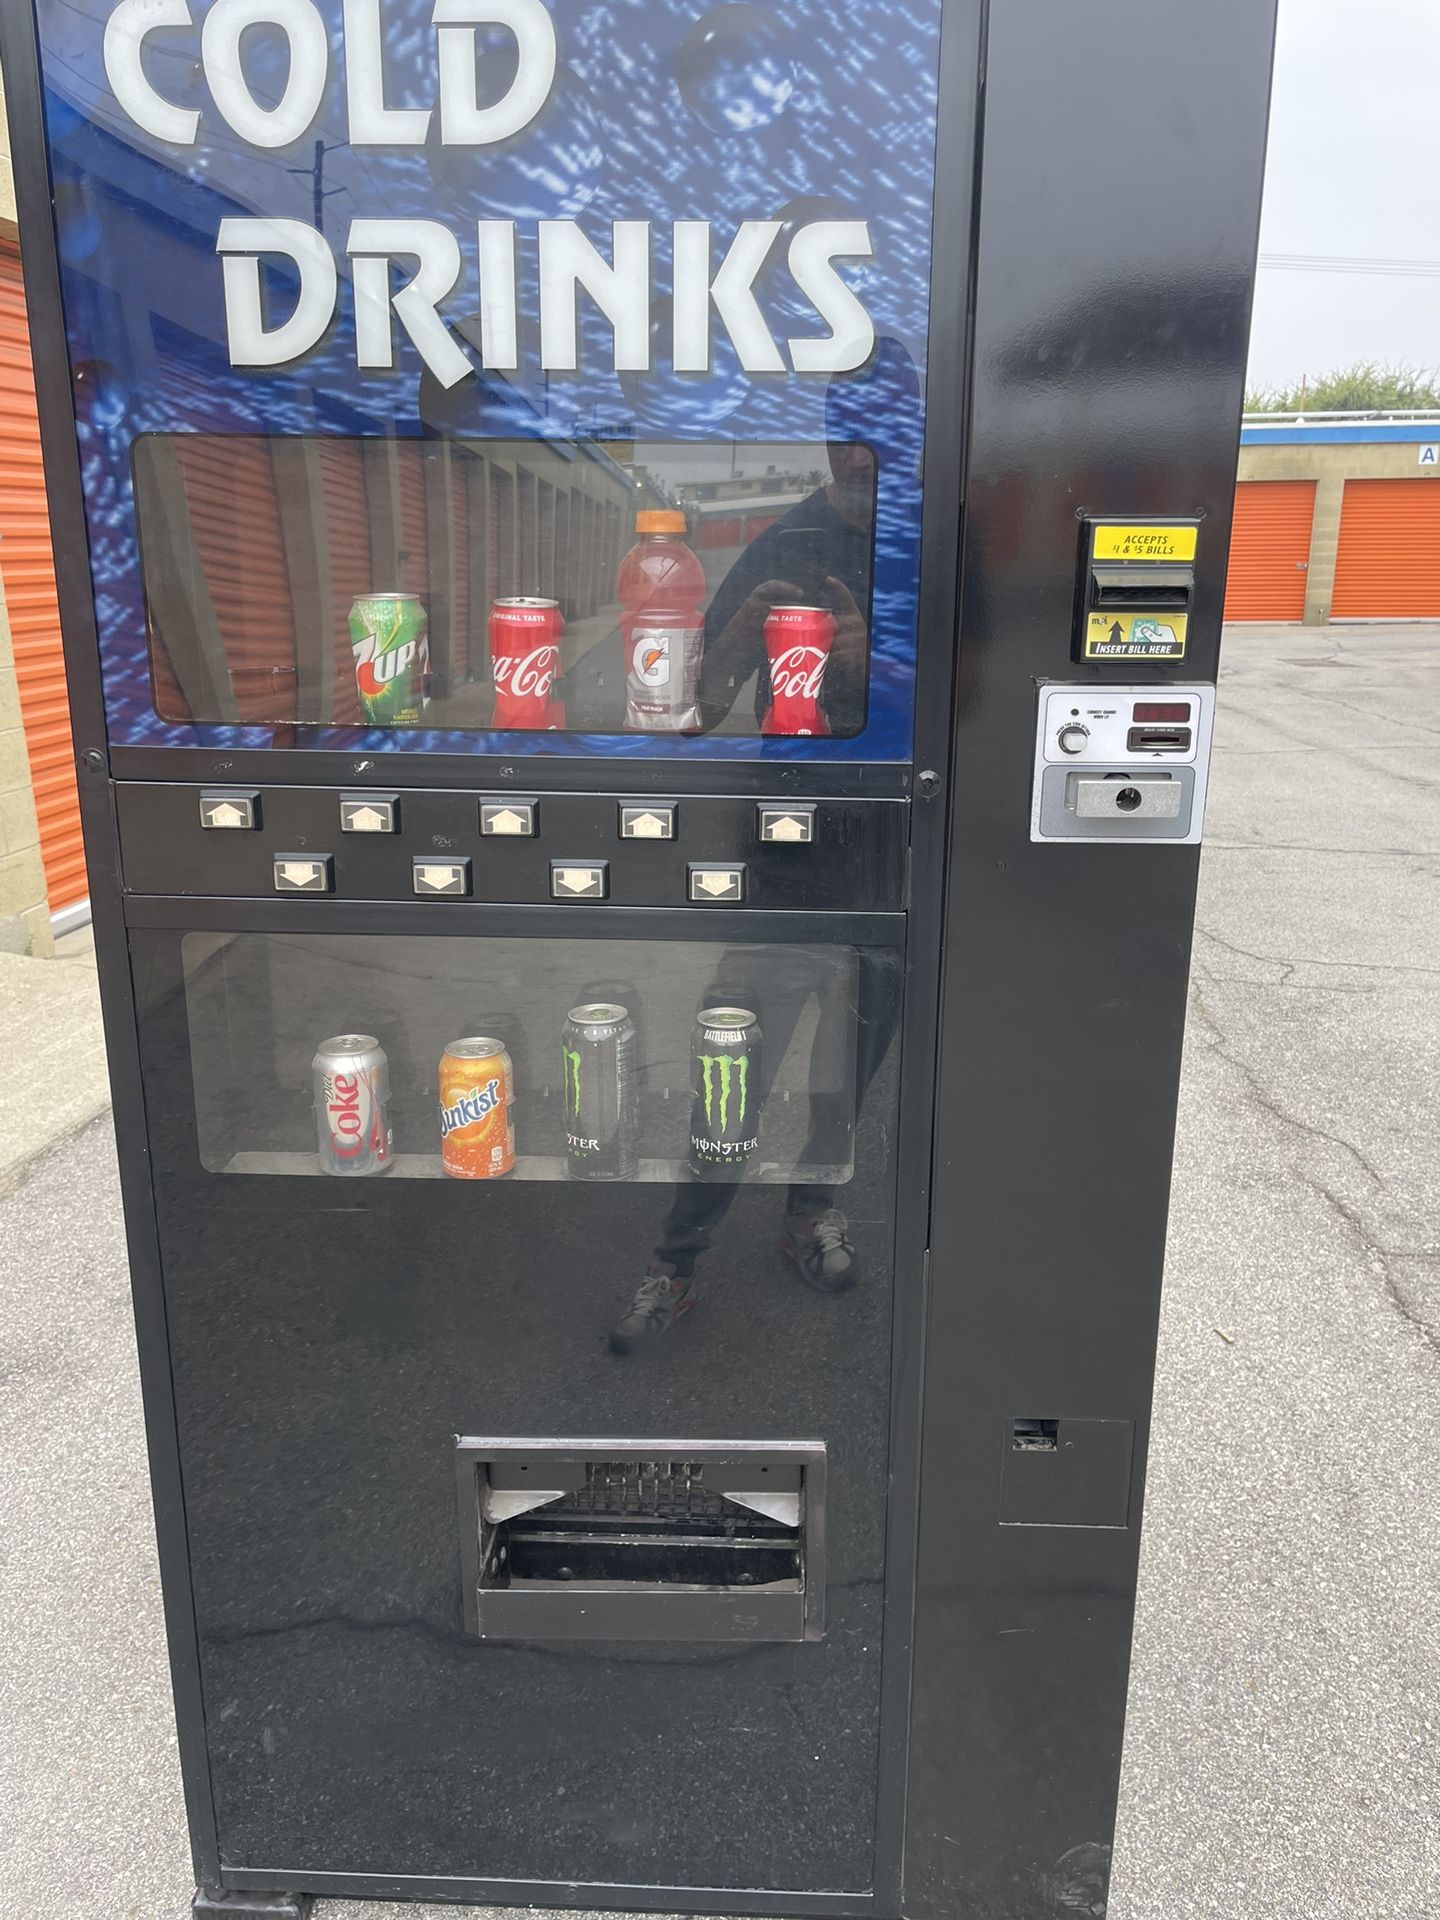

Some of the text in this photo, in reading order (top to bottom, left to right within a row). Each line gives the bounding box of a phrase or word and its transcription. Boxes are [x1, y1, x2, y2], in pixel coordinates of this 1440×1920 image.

[104, 0, 556, 148] COLD
[216, 217, 876, 389] DRINKS
[1421, 447, 1435, 462] A
[1124, 535, 1168, 545] ACCEPTS
[1122, 545, 1130, 554] &
[1134, 545, 1143, 554] $5
[1146, 546, 1175, 555] BILLS
[523, 614, 546, 622] TASTE
[1096, 642, 1172, 654] INSERT BILL HERE
[633, 637, 670, 687] G
[703, 1029, 742, 1043] BATTLEFIELD
[329, 1072, 362, 1158] Coke
[691, 1135, 758, 1155] MONSTER
[697, 1153, 751, 1163] ENERGY
